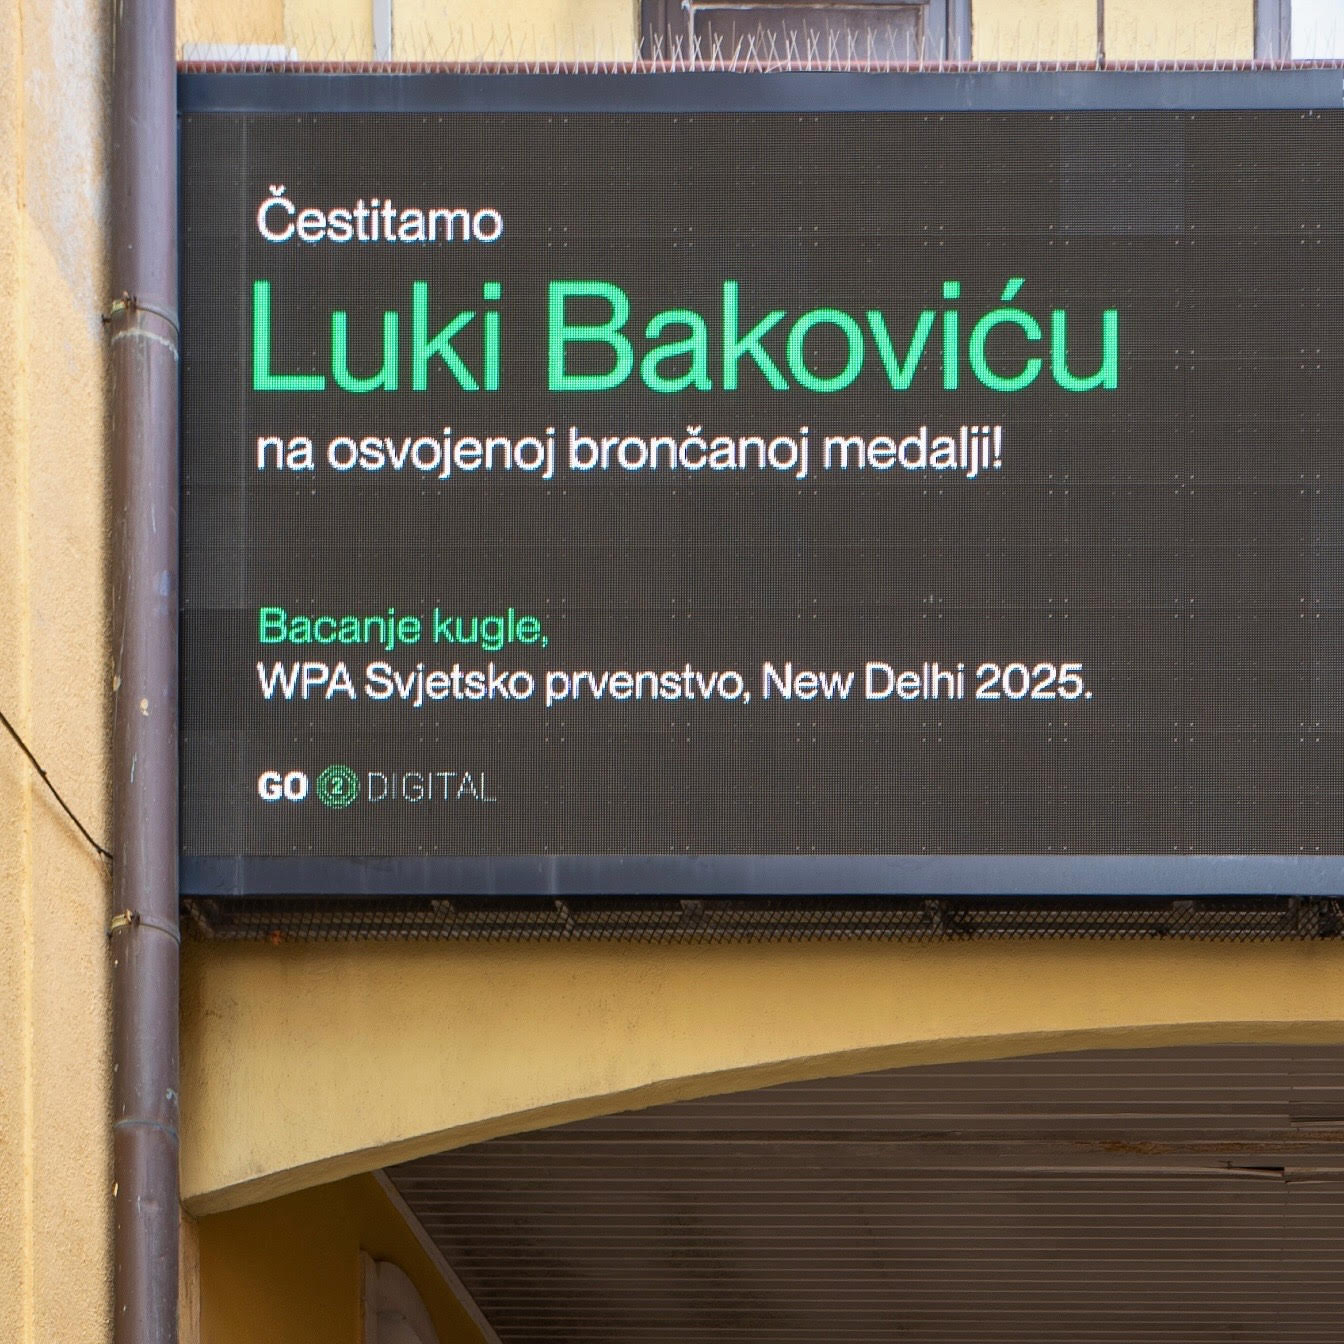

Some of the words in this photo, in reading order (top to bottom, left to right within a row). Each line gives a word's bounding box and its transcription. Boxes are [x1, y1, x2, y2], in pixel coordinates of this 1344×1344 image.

[256, 184, 504, 244] Čestitamo
[252, 280, 501, 392] Luki
[548, 278, 1118, 394] Bakoviću
[256, 432, 314, 472] na
[327, 426, 556, 480] osvojenoj
[569, 425, 809, 480] brončanoj
[823, 425, 1003, 480] medalji!
[258, 606, 421, 652] Bacanje
[433, 606, 549, 652] kugle,
[256, 663, 355, 701] WPA
[364, 662, 535, 708] Svjetsko
[545, 667, 752, 708] prvenstvo,
[763, 663, 854, 701] New
[864, 662, 965, 701] Delhi
[975, 663, 1093, 701] 2025.
[257, 770, 308, 803] GO
[367, 771, 498, 803] DIGITAL
